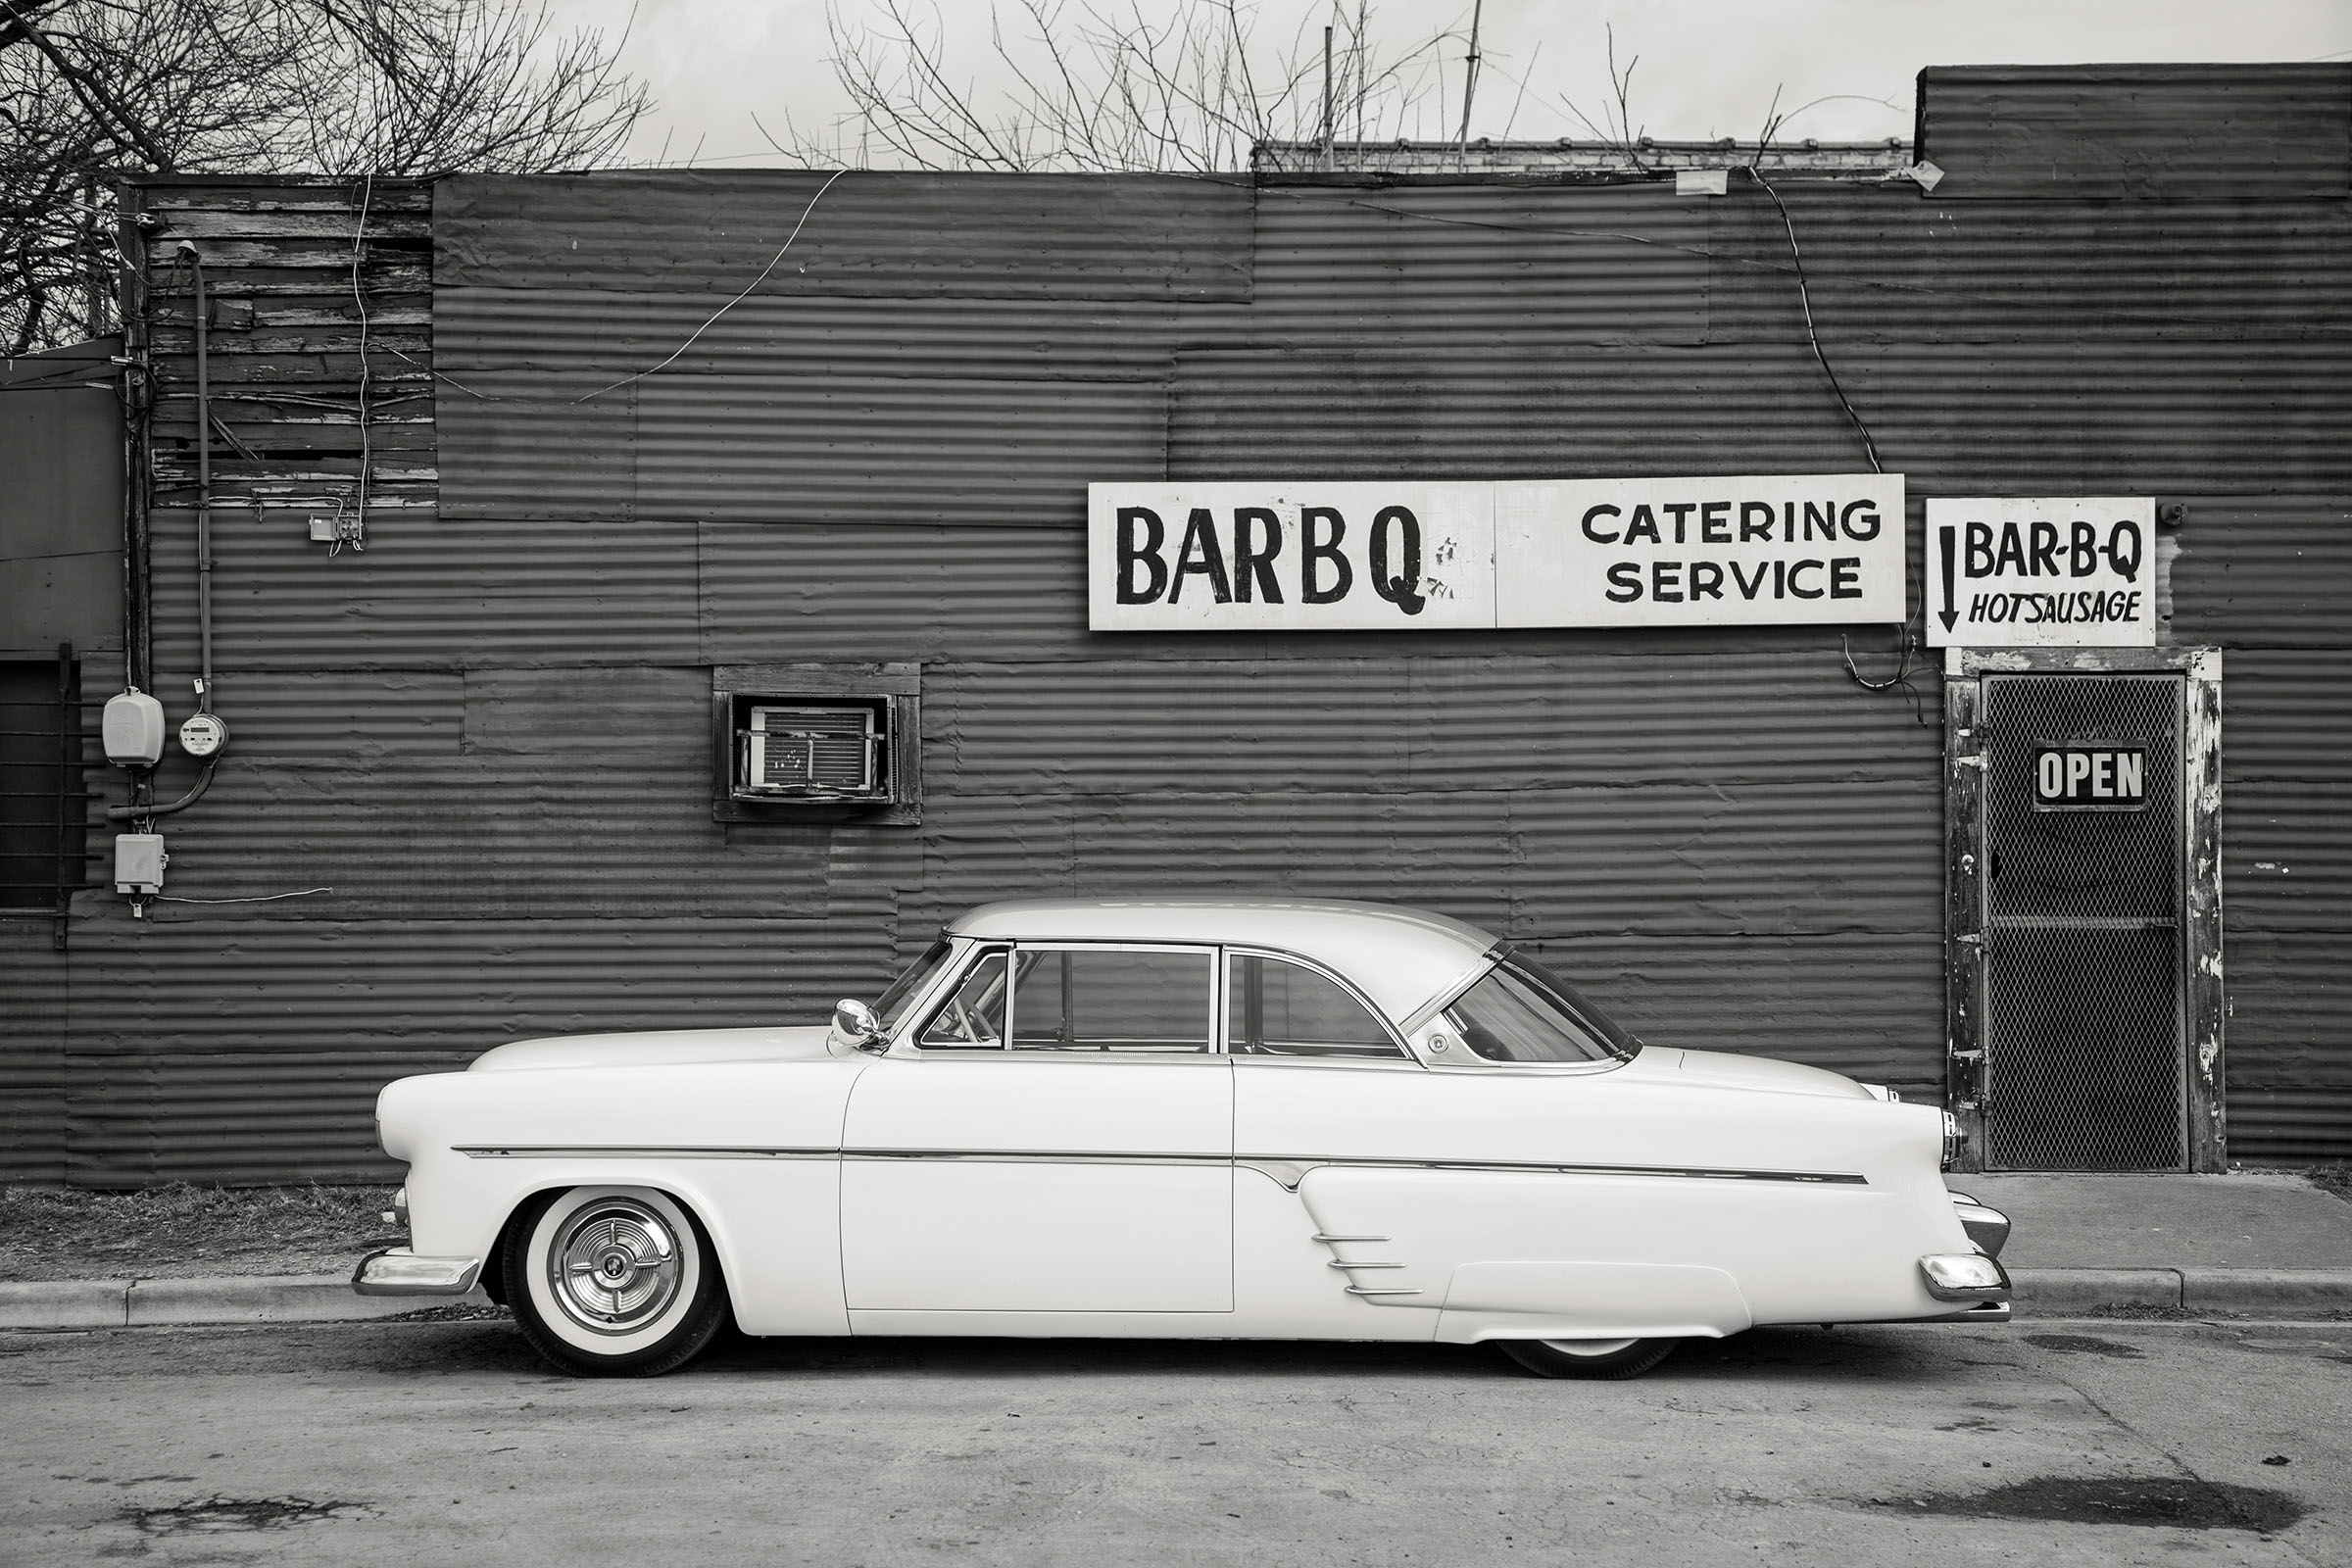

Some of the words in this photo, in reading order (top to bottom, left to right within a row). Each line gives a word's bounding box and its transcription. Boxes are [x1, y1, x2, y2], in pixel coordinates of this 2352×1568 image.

[1581, 499, 1882, 546] CATERING
[1964, 519, 2142, 584] BAR-B-Q
[1605, 557, 1863, 604] SERVICE
[2038, 752, 2143, 798] OPEN
